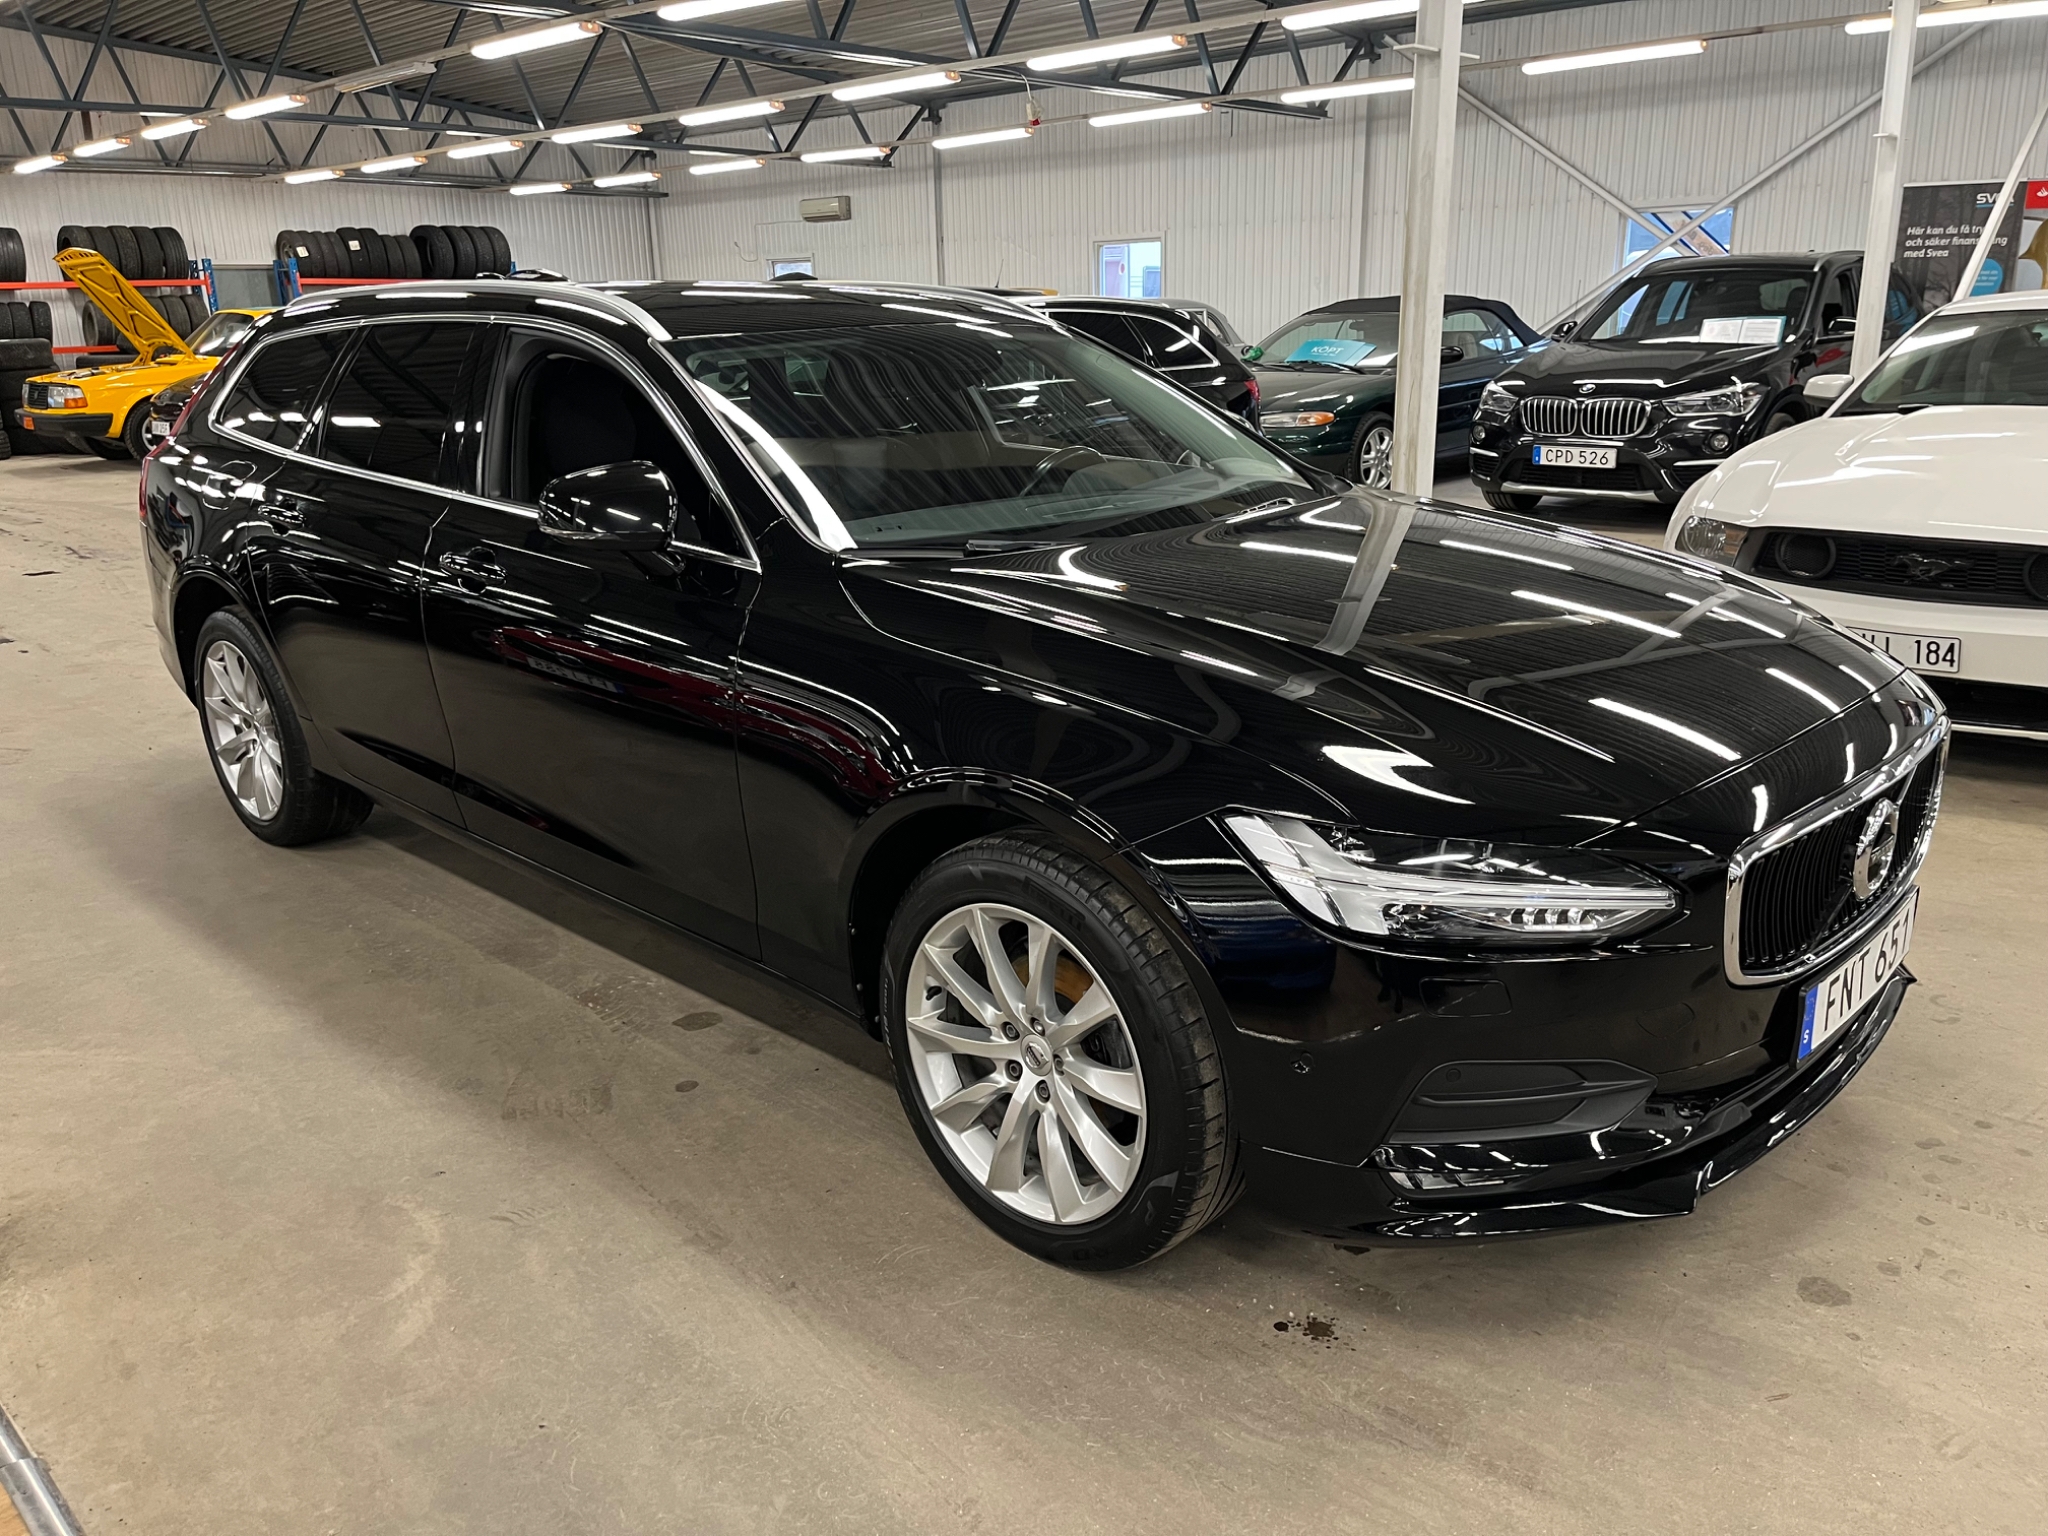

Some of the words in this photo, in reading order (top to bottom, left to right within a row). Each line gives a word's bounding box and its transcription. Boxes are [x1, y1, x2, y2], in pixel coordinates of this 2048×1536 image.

[1907, 226, 1925, 235] Här
[1926, 225, 1944, 235] kan
[1945, 225, 1959, 235] du
[1960, 224, 1970, 234] få
[1905, 237, 1923, 247] och
[1924, 236, 1951, 246] säker
[1904, 249, 1925, 257] med
[1926, 249, 1949, 257] Svea
[1545, 449, 1574, 464] CPD
[1578, 450, 1609, 465] 526
[1914, 639, 1956, 668] 184
[1824, 947, 1871, 1032] FNT
[1874, 908, 1910, 983] 651
[1803, 1029, 1810, 1044] S
